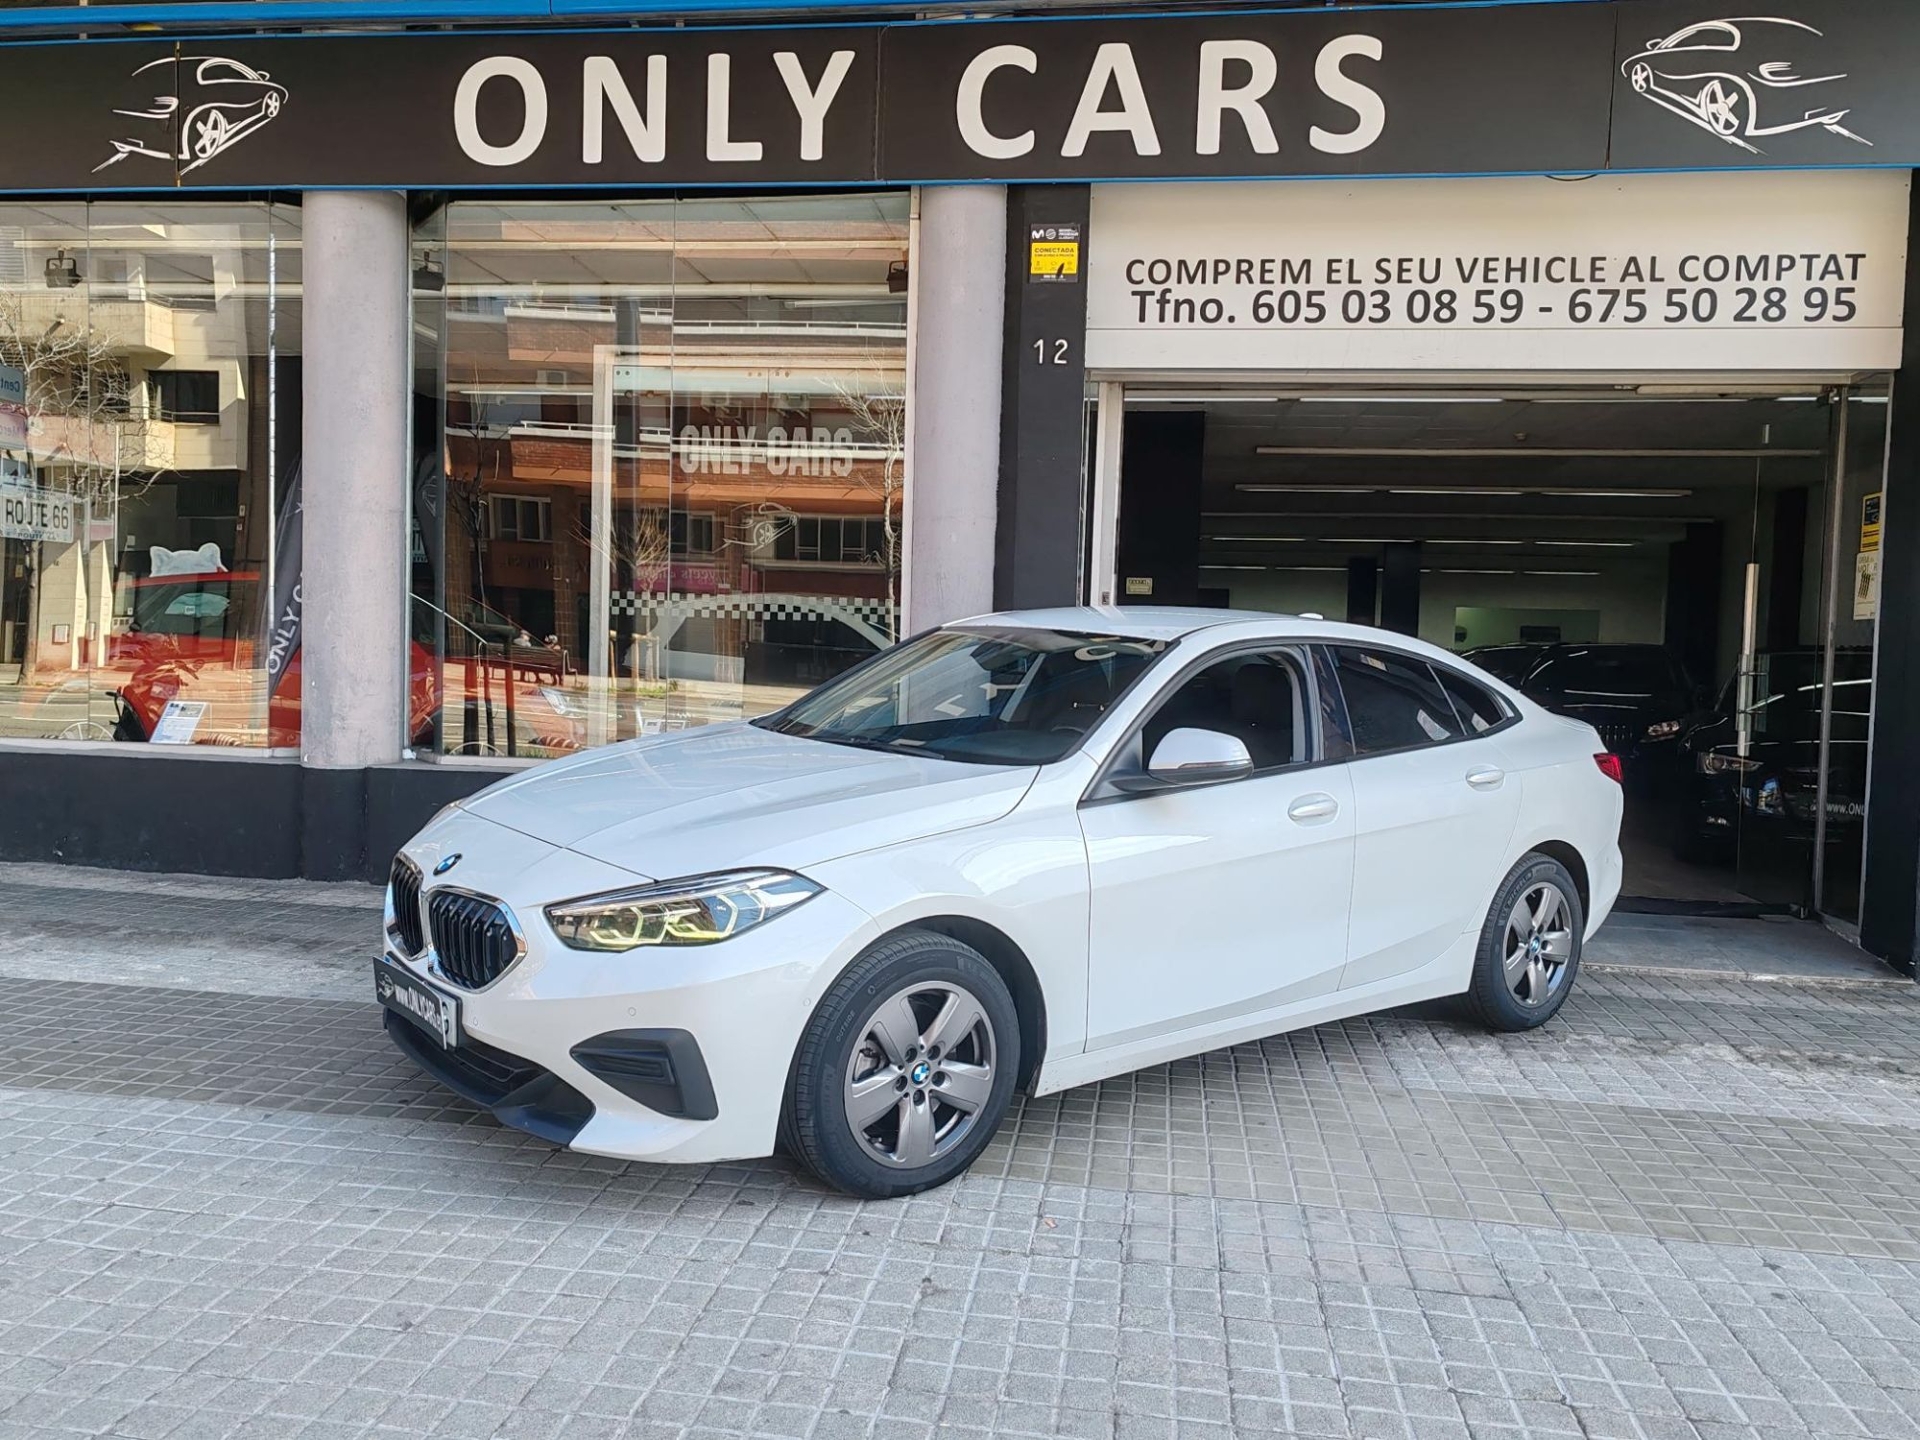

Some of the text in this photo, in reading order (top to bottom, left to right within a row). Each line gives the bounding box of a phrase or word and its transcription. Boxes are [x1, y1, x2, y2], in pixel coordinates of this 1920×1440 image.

[453, 34, 1387, 166] ONLY CARS
[1125, 253, 1867, 286] COMPREM EL SEU VEHICLE AL COMPTAT
[1130, 287, 1237, 325] Tfno.
[1252, 289, 1327, 325] 605
[1341, 289, 1392, 324] 03
[1406, 289, 1458, 324] 08
[1472, 288, 1524, 324] 59
[1568, 288, 1648, 324] 675
[1664, 287, 1718, 323] 50
[1733, 286, 1787, 323] 28
[1803, 286, 1857, 323] 95
[679, 423, 854, 477] ONLY CARS
[52, 505, 69, 530] 66
[265, 604, 300, 675] ONLY
[835, 1010, 856, 1042] OUTSIDE
